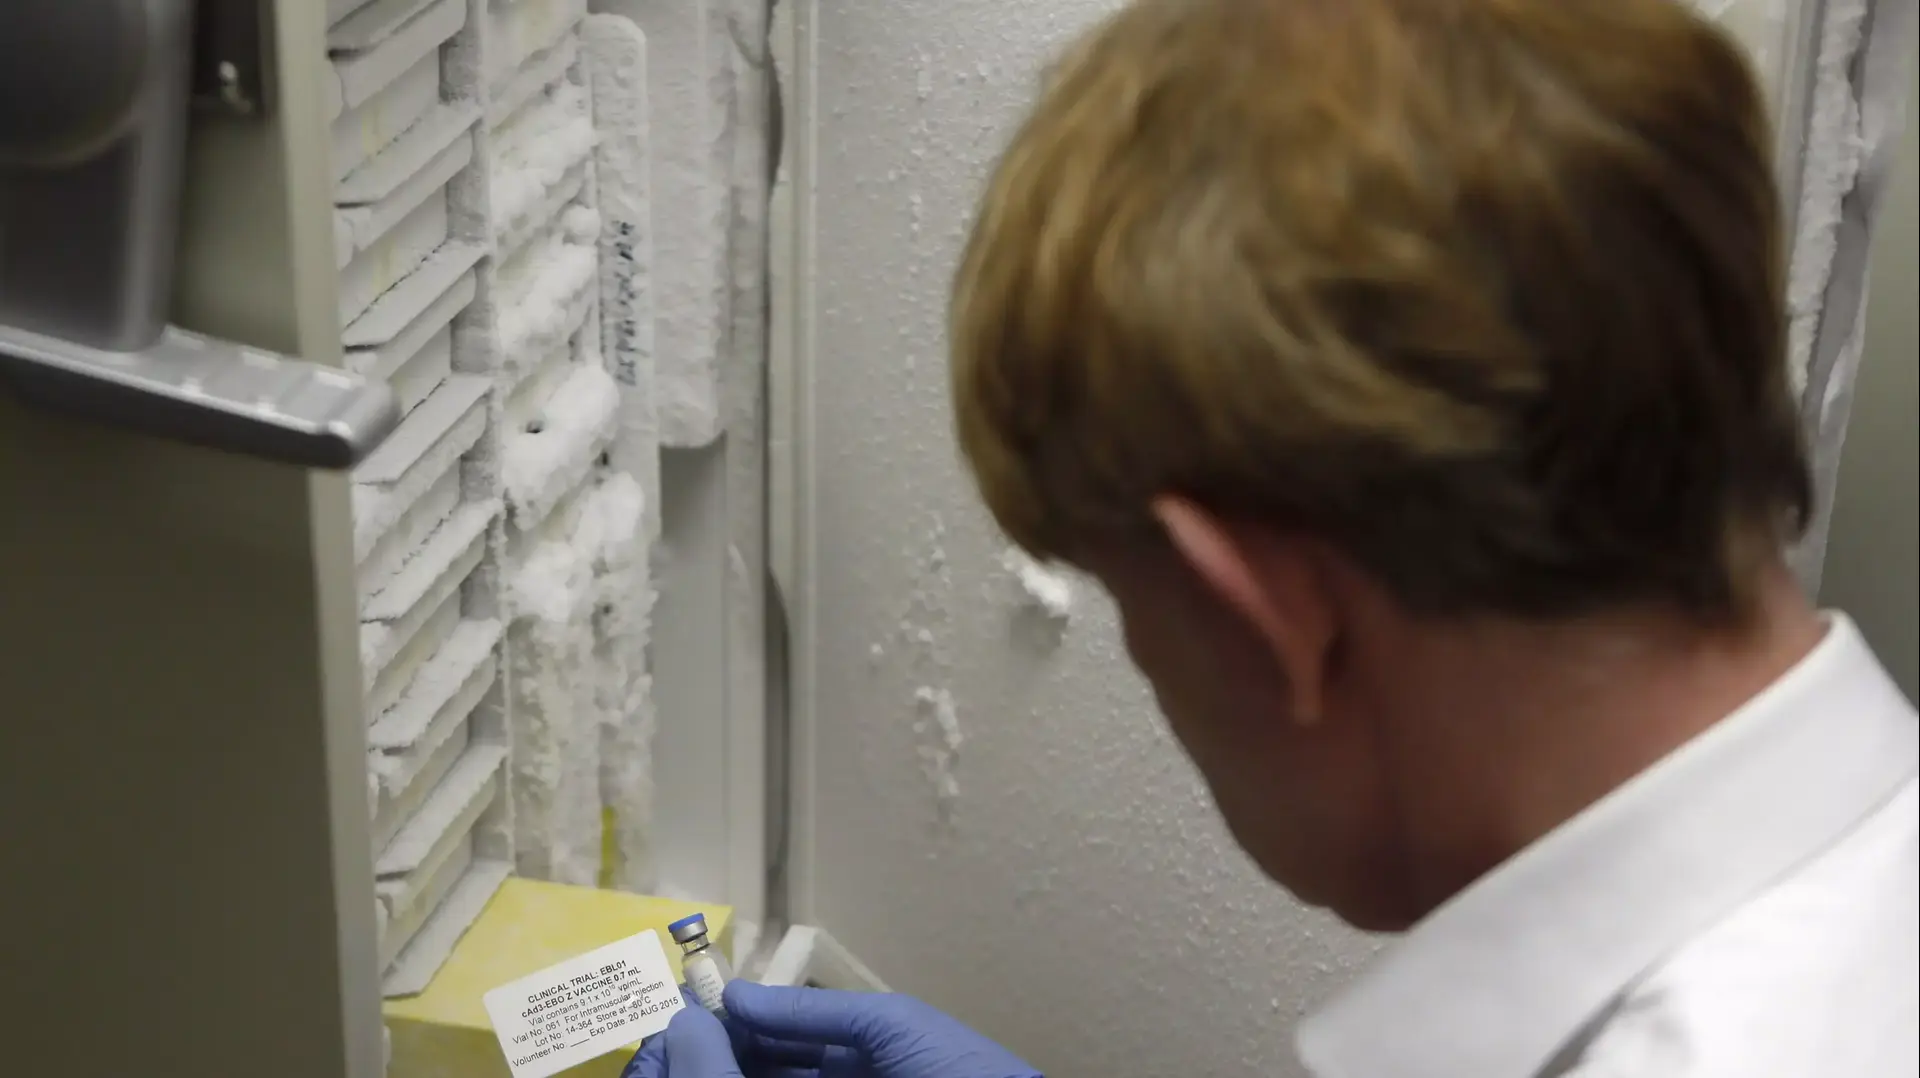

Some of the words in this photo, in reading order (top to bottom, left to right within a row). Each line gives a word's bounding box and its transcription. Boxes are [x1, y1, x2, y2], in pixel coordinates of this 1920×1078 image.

[522, 996, 564, 1018] cAd3-EBO
[566, 992, 573, 1000] Z
[573, 977, 612, 996] VACCINE
[614, 972, 625, 981] 0.7
[628, 966, 641, 976] mL
[528, 983, 569, 1003] CLINICAL
[570, 972, 598, 987] TRIAL:
[600, 960, 626, 975] EBL01
[528, 1015, 544, 1026] Vial
[546, 1002, 579, 1019] contains
[618, 978, 642, 994] vp/mL
[512, 1033, 528, 1044] Vial
[564, 1013, 578, 1023] For
[580, 992, 631, 1018] Intramuscular
[633, 981, 664, 997] Injection
[512, 1048, 551, 1067] Volunteer
[590, 1026, 606, 1037] Exp
[629, 1012, 639, 1022] 20
[641, 1004, 658, 1017] AUG
[660, 996, 679, 1010] 2015
[534, 1036, 548, 1047] Lot
[596, 1011, 617, 1022] Store
[618, 1006, 627, 1014] at
